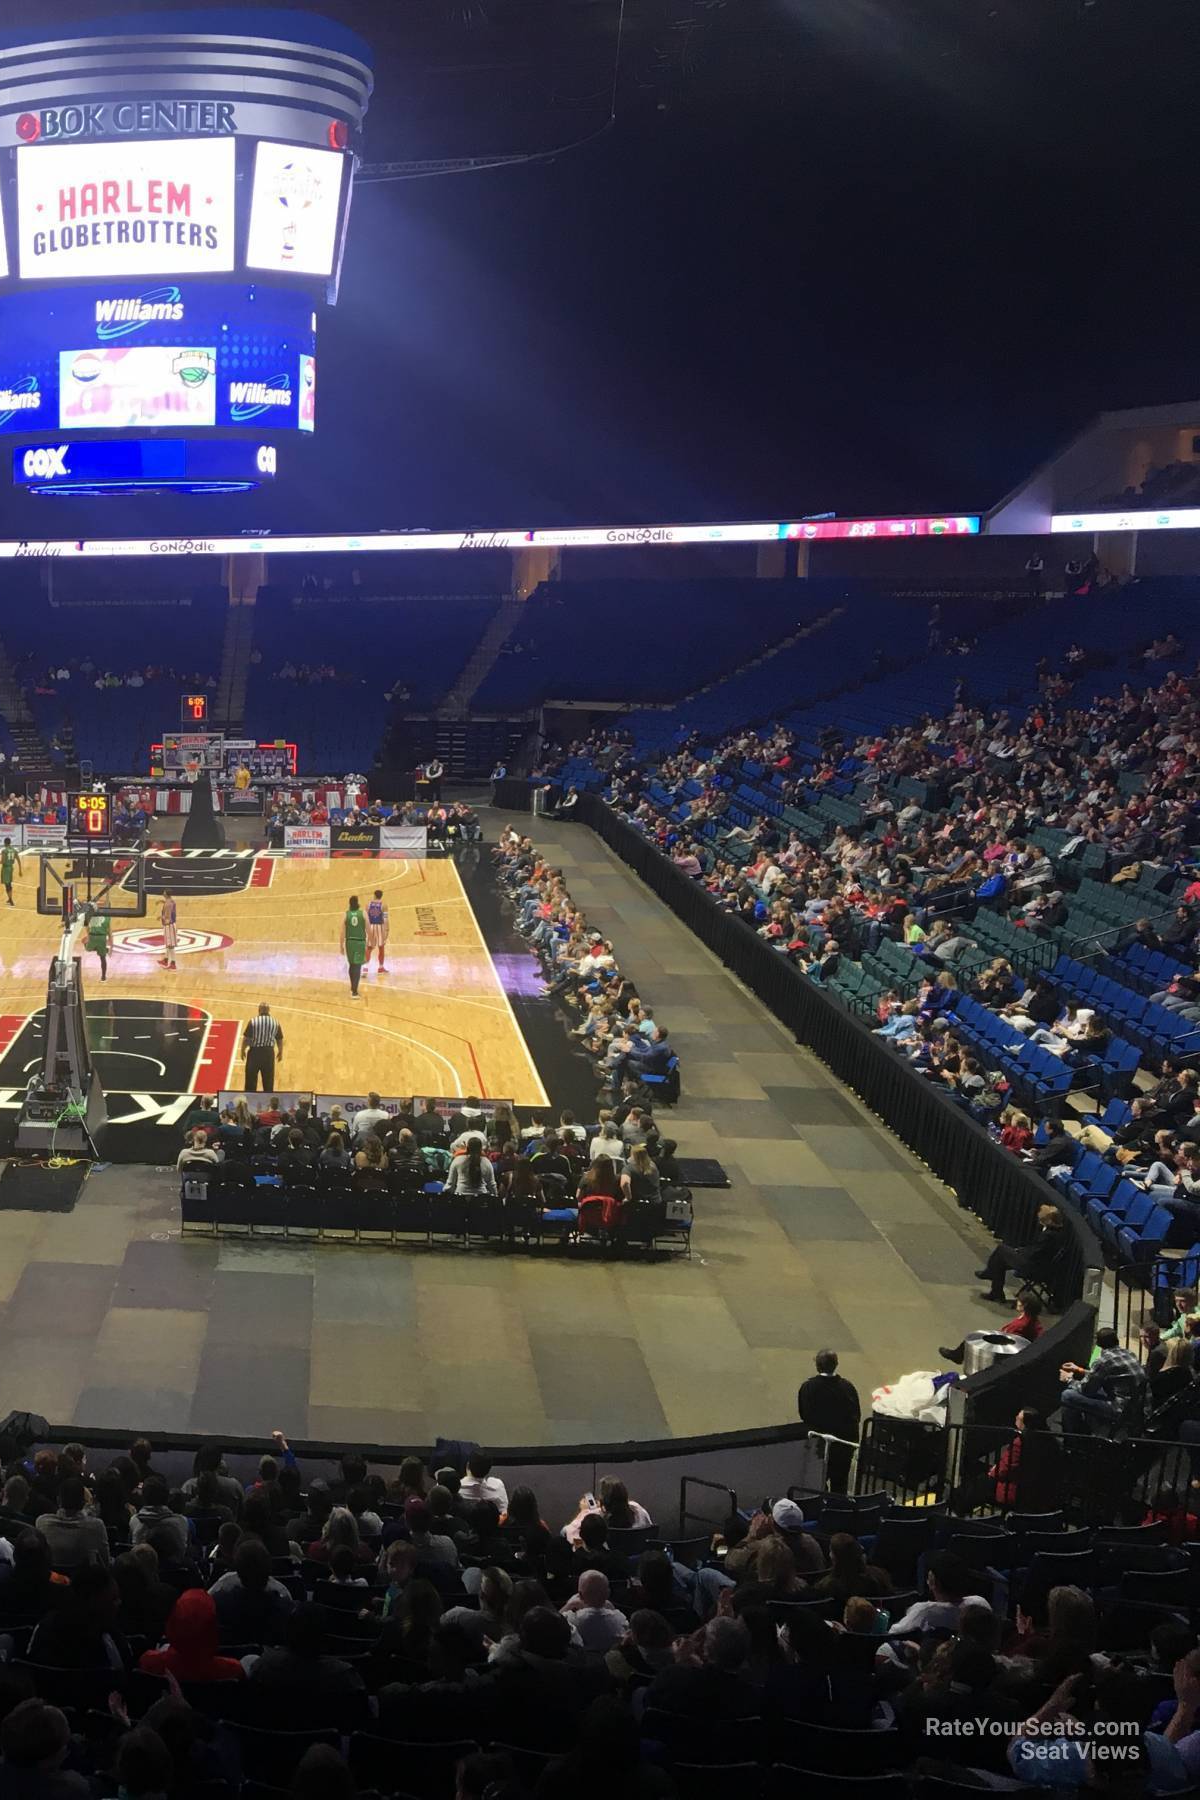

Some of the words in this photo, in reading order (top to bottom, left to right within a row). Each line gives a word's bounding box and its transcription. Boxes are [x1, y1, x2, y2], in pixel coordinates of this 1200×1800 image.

[40, 104, 105, 137] BOK
[112, 101, 239, 132] CENTER
[59, 179, 191, 222] HARLEM
[33, 219, 218, 256] GLOBETROTTERS
[95, 298, 184, 321] Williams
[229, 382, 292, 406] Williams
[188, 697, 205, 706] 6:05
[79, 796, 106, 809] 6:05
[292, 830, 323, 839] HARLEM
[337, 831, 374, 842] Baden
